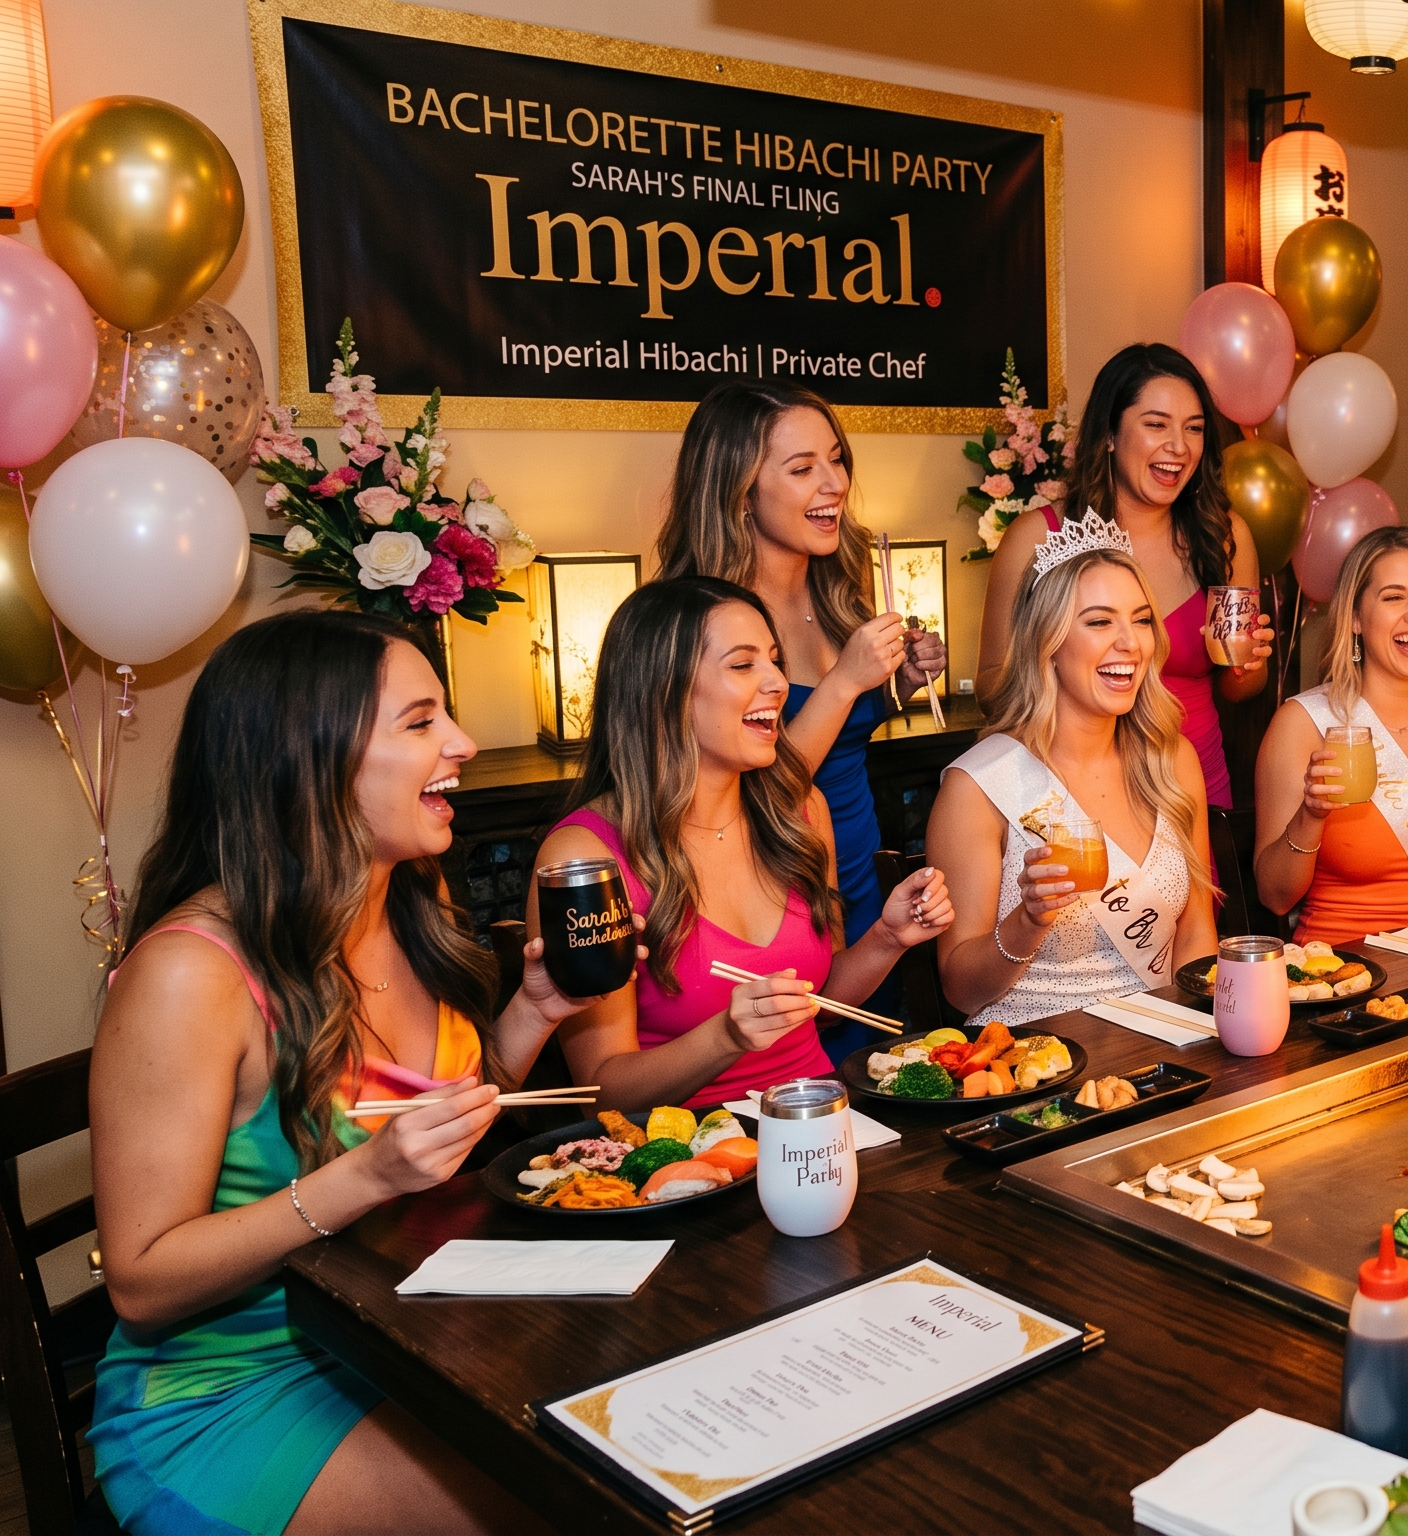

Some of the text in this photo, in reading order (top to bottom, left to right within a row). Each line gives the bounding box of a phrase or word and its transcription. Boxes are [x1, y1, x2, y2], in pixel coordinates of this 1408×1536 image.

[386, 82, 993, 195] BACHELORETTE HIBACHI PARTY
[571, 161, 840, 216] SARAH'S FINAL FLING
[501, 336, 629, 375] Imperial
[640, 340, 749, 374] Hibachi
[772, 348, 863, 379] Private
[869, 351, 927, 380] Chef
[782, 1130, 848, 1169] Imperial
[905, 1315, 953, 1340] MENU
[929, 1294, 1002, 1332] Imperial
